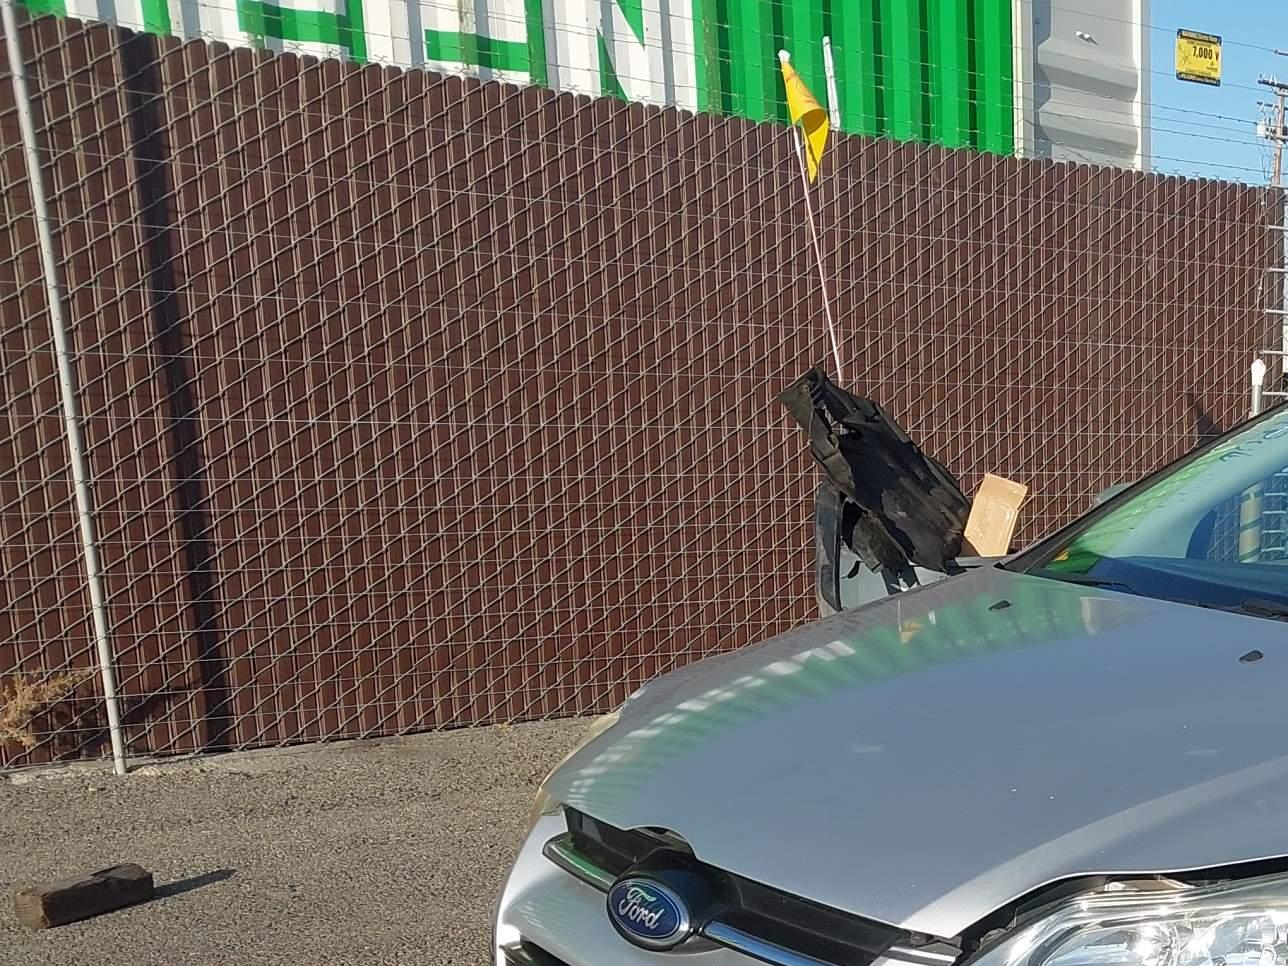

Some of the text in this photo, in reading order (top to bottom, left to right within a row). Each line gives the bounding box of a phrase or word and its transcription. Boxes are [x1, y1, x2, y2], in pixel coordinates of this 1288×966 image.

[1193, 46, 1219, 61] 7,000 V
[619, 887, 665, 930] Ford
